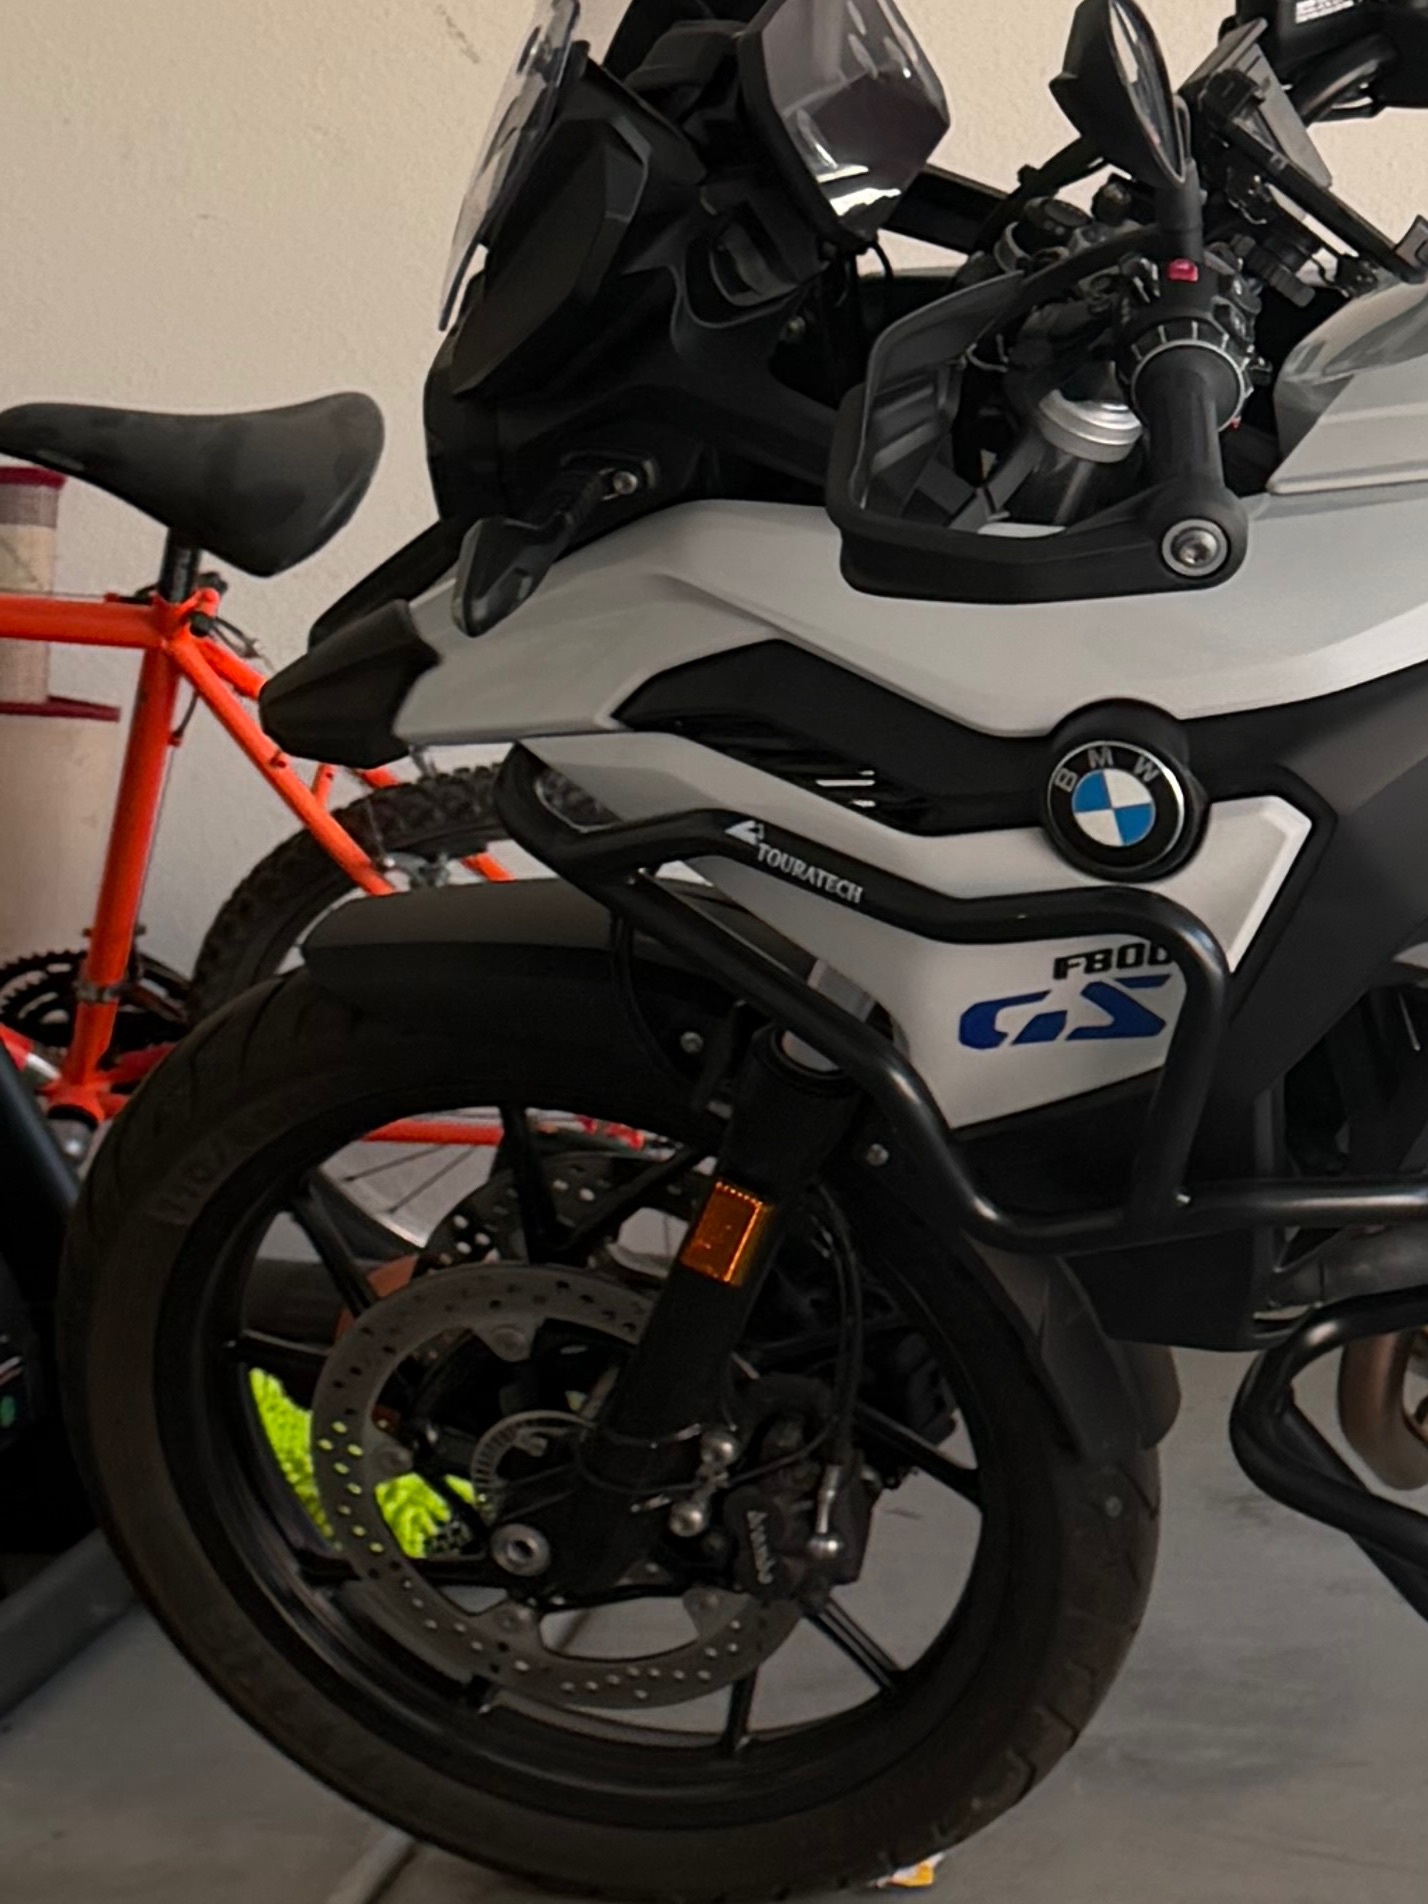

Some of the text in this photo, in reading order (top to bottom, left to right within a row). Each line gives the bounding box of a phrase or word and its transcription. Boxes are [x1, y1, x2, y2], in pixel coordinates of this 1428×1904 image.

[1054, 746, 1160, 793] BMW
[757, 842, 863, 904] TOURATECH
[1053, 942, 1173, 980] F800
[958, 973, 1172, 1050] GS
